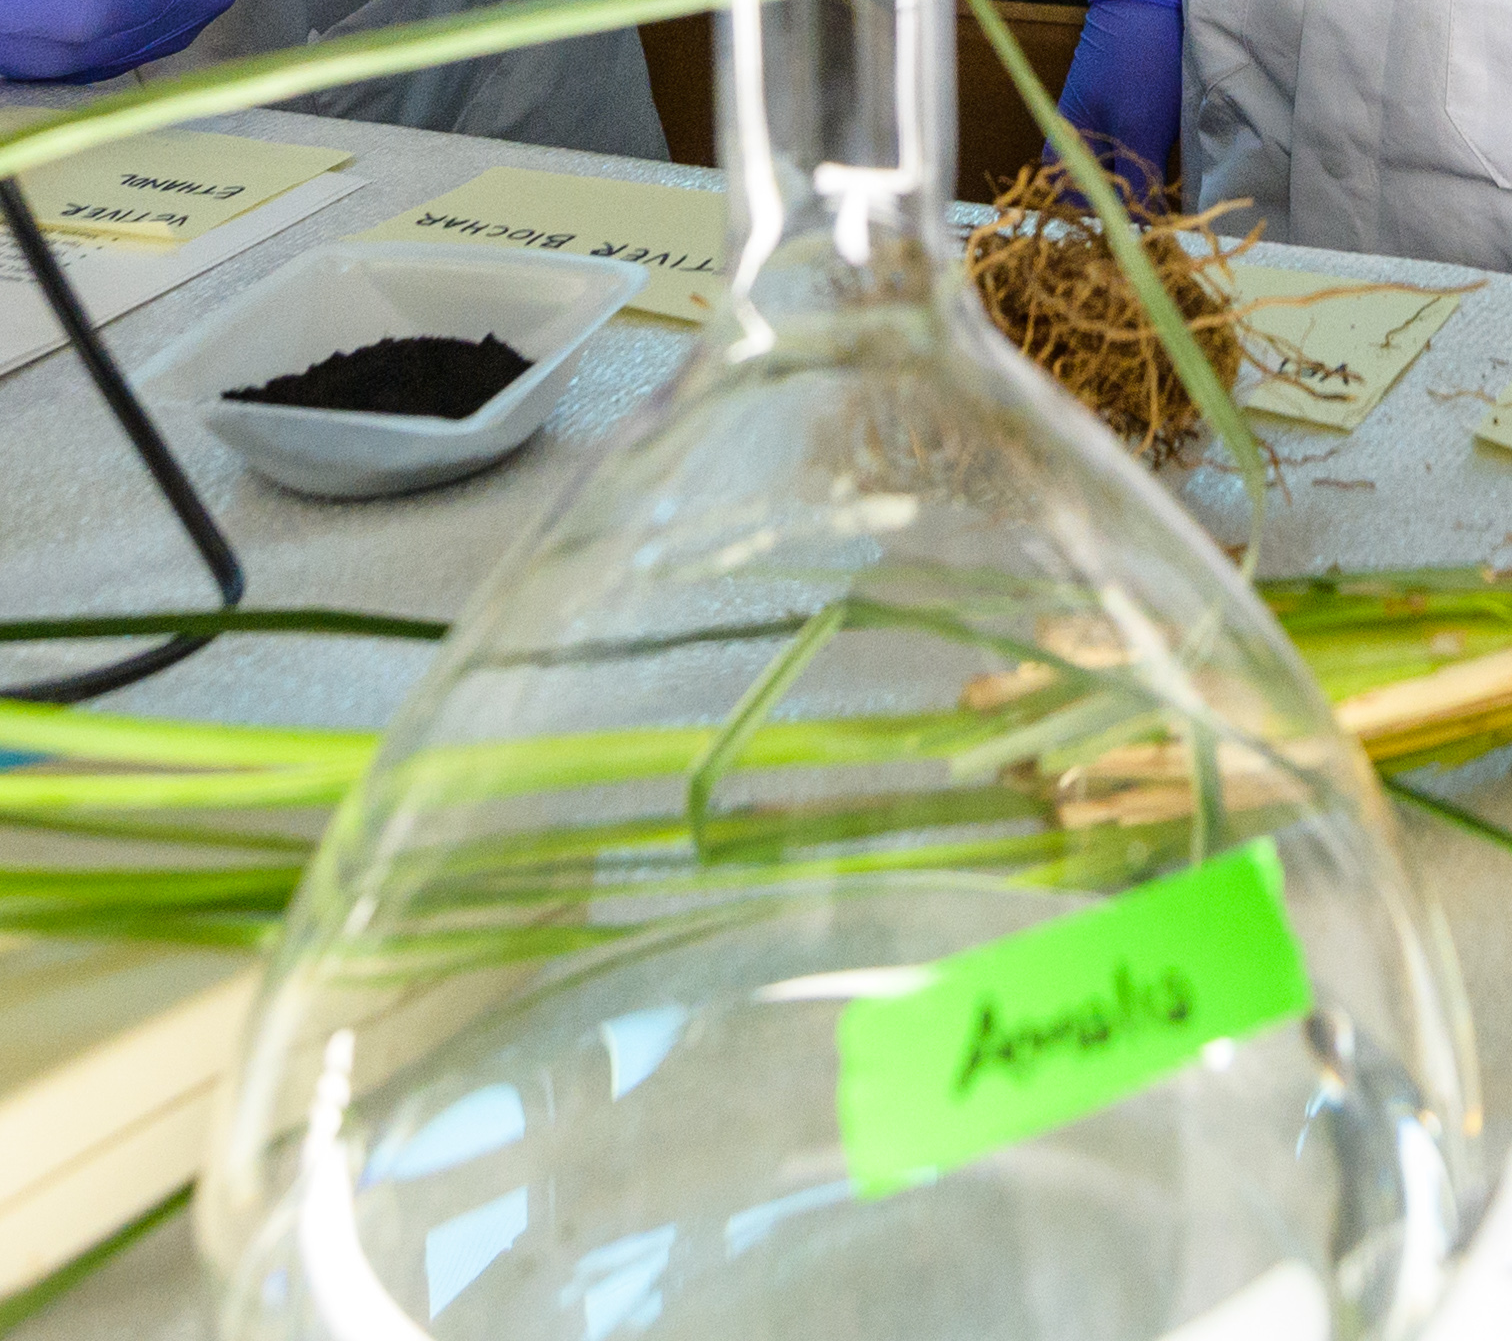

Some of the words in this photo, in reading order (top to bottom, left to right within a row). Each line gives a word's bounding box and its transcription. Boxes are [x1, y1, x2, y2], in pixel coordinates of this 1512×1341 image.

[119, 173, 246, 201] ETHANOL
[60, 200, 188, 229] VETIVER
[415, 210, 577, 250] BIOCHAR
[589, 240, 722, 275] TIVER
